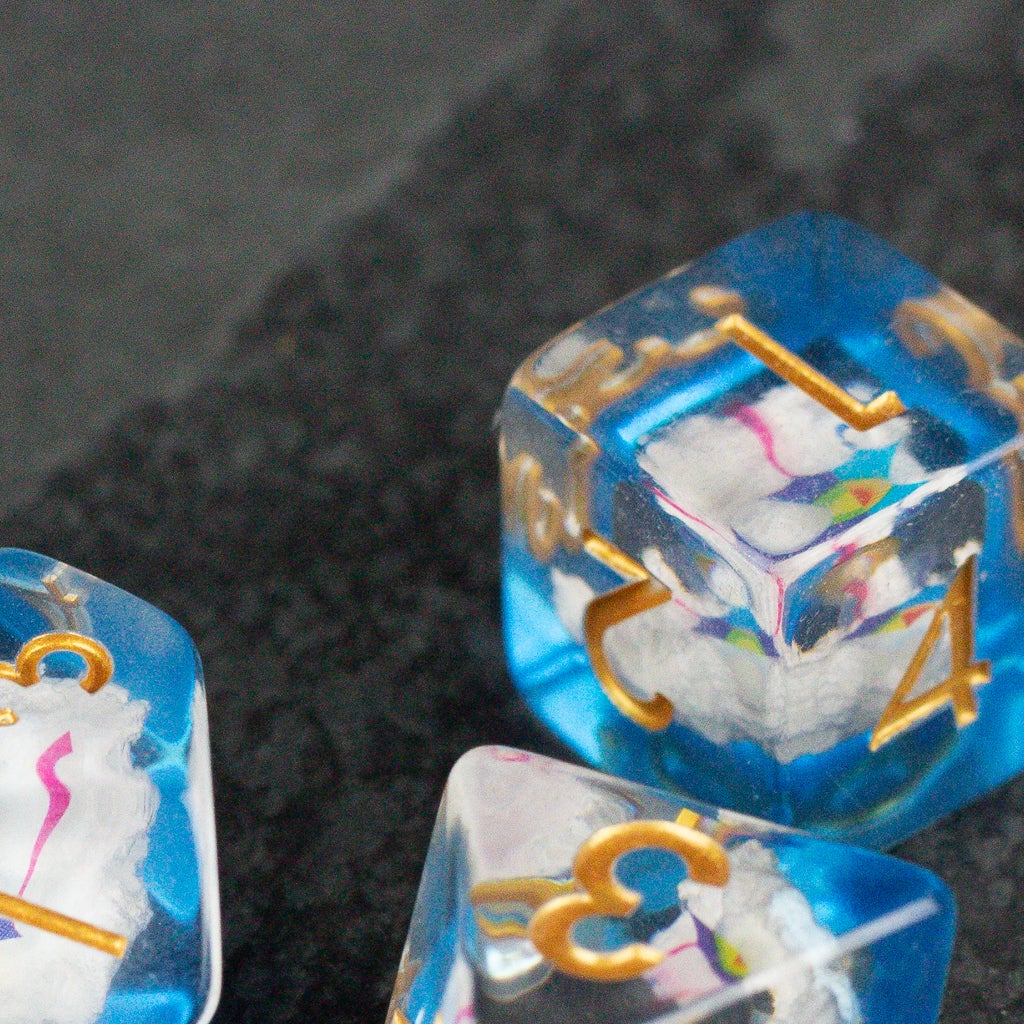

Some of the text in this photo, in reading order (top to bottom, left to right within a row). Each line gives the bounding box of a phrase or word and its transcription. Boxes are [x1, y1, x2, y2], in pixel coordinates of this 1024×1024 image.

[717, 313, 907, 432] 1
[871, 554, 991, 752] 4
[529, 820, 730, 981] 3
